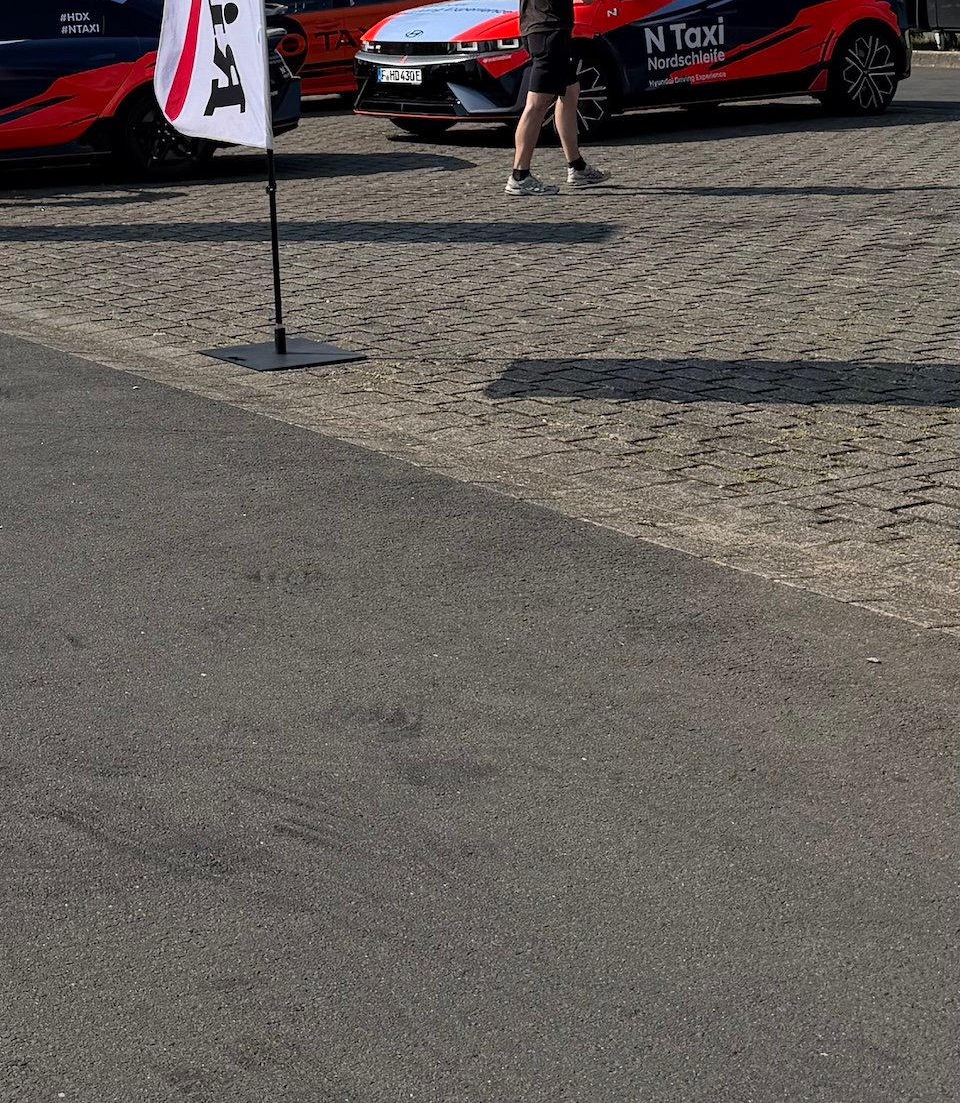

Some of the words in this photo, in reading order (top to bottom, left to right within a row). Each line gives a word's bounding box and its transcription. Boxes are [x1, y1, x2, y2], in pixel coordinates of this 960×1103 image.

[60, 12, 90, 22] #HDX
[61, 24, 100, 34] #NTAXI
[644, 25, 666, 54] N
[669, 16, 725, 50] Taxi
[647, 48, 726, 71] Nordschleife
